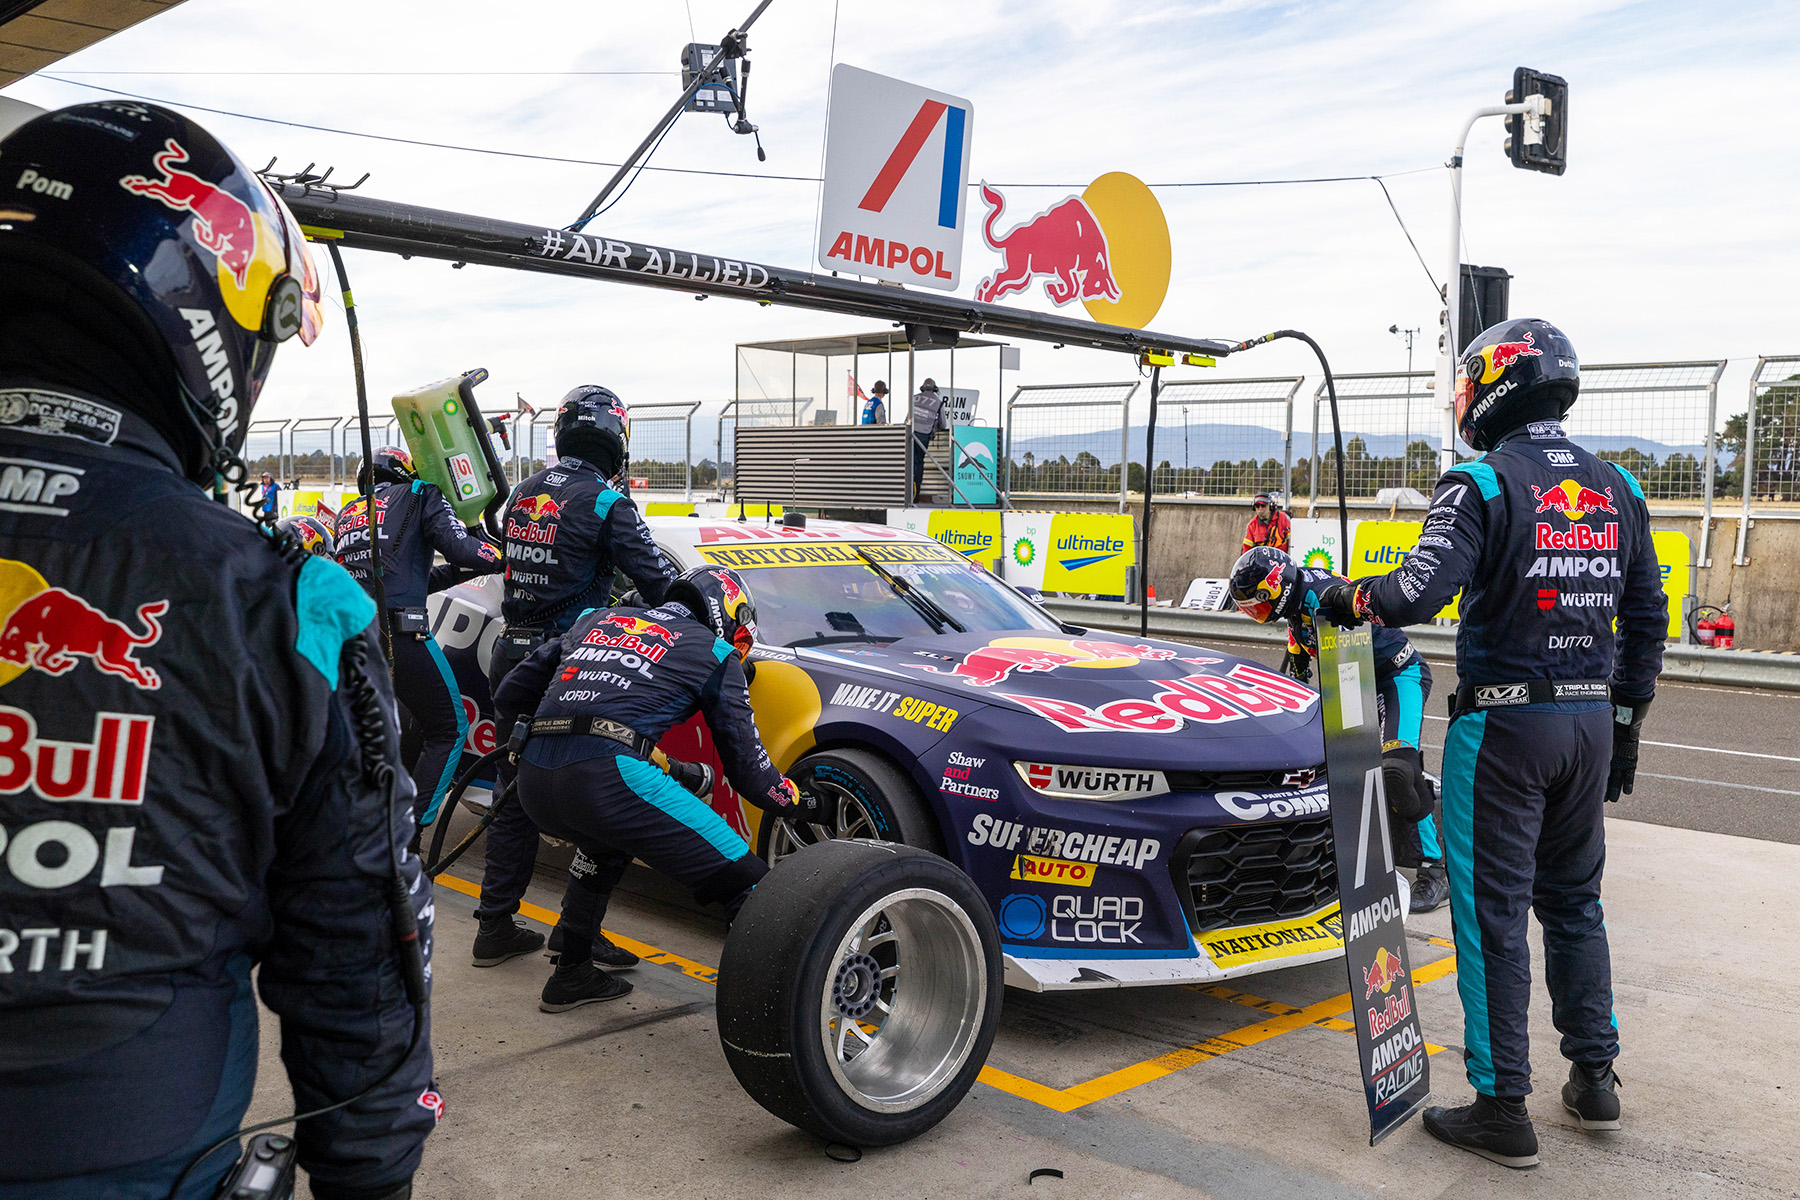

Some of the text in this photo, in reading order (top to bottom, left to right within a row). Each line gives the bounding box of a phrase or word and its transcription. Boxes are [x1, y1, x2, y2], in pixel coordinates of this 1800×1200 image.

[16, 168, 74, 200] Pom
[541, 230, 769, 288] #AIR ALLIED
[827, 231, 952, 280] AMPOL
[1558, 359, 1575, 369] Dutto
[1472, 380, 1518, 421] AMPOL
[960, 411, 971, 421] ON
[1547, 452, 1575, 464] OMP
[546, 474, 567, 485] OMP
[957, 472, 976, 480] SNOWY
[907, 522, 916, 530] bp
[935, 529, 992, 545] ultimate
[1026, 526, 1036, 536] bp
[1057, 534, 1124, 552] ultimate
[1322, 535, 1336, 546] bp
[705, 546, 856, 567] NATIONAL
[1525, 556, 1622, 578] AMPOL
[1274, 583, 1292, 615] AMPOL
[708, 596, 725, 640] AMPO
[1320, 635, 1337, 650] LOOK
[1338, 635, 1350, 648] FOR
[1549, 635, 1593, 649] DUTTO
[566, 647, 655, 680] AMPOL
[559, 690, 600, 702] JORDY
[1509, 697, 1528, 705] WEAR
[830, 683, 959, 733] MAKE IT SUPER
[947, 751, 985, 769] Shaw
[943, 766, 970, 780] and
[940, 776, 999, 800] Partners
[1262, 791, 1293, 799] PARTS
[967, 813, 1160, 871] SUPERCHEAP
[0, 820, 165, 888] OL
[1023, 858, 1087, 881] AUTO
[1052, 894, 1144, 920] QUAD
[1349, 893, 1401, 943] AMPOL
[1051, 919, 1144, 944] LOCK
[1207, 924, 1328, 959] NATIONAL
[1371, 1022, 1422, 1077] AMPOL
[1374, 1050, 1423, 1106] RACING
